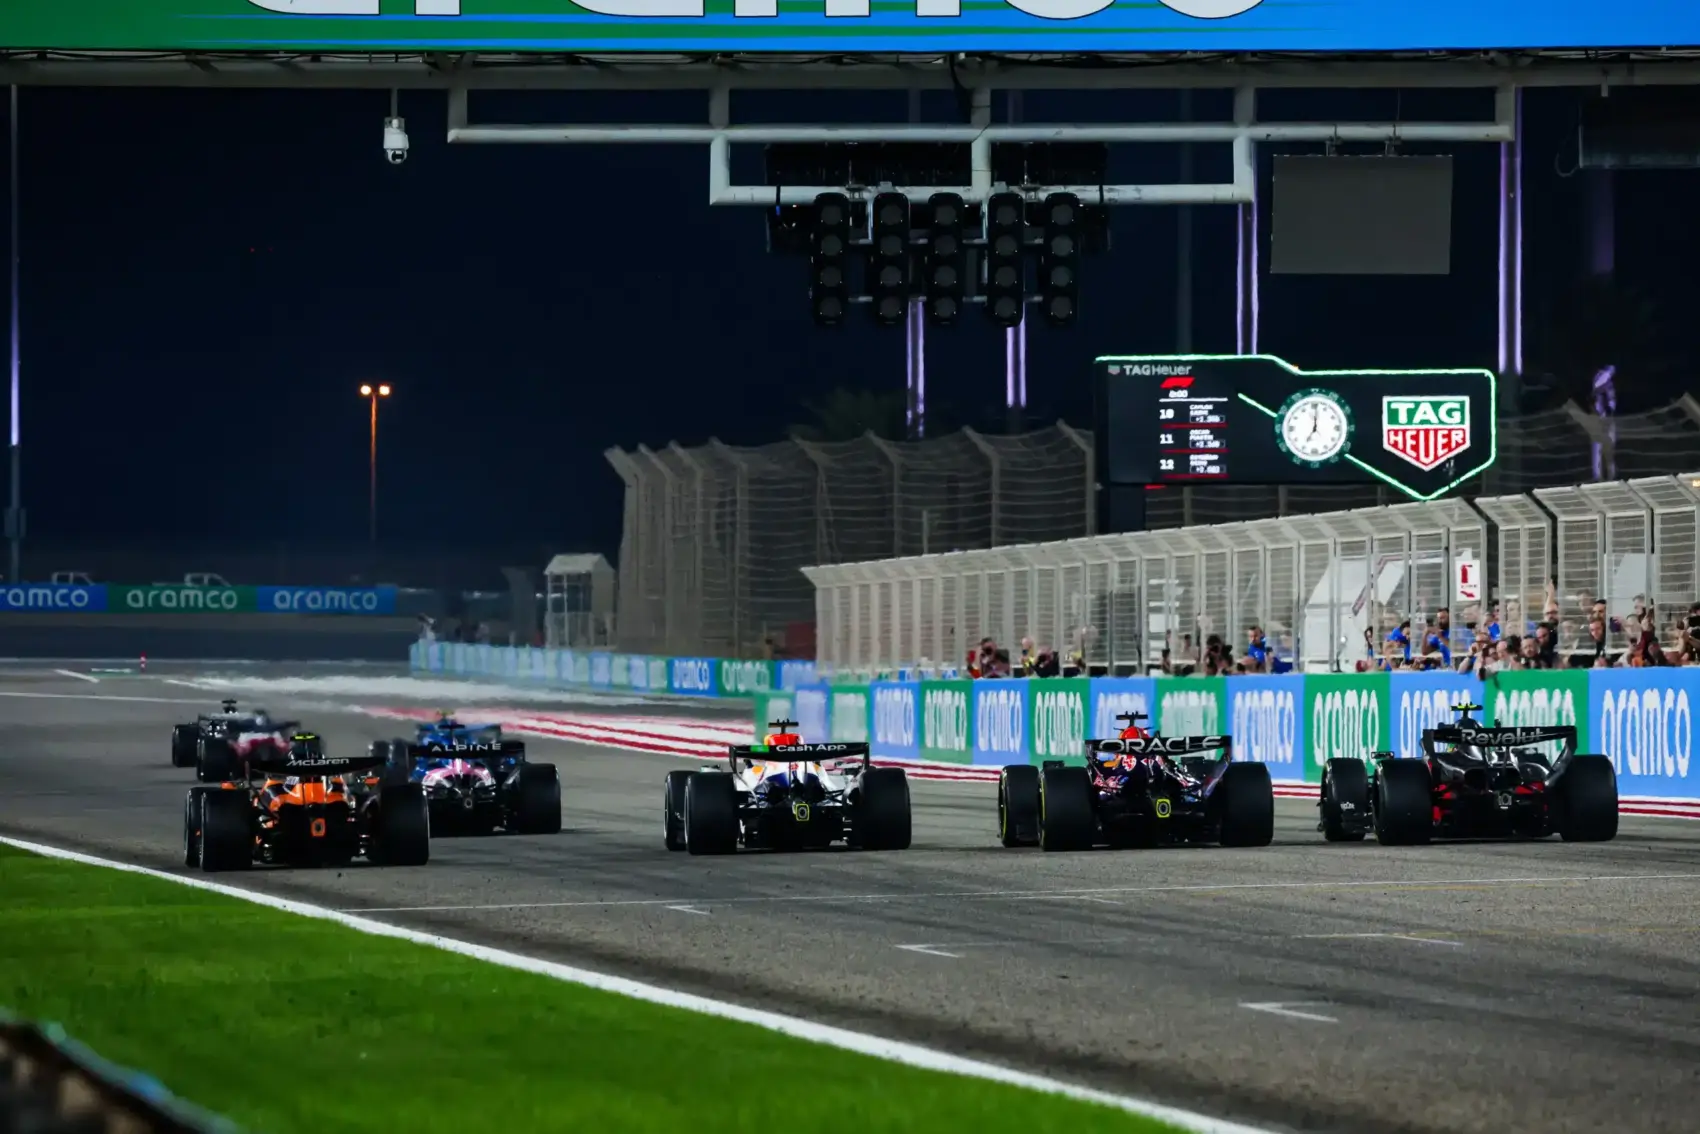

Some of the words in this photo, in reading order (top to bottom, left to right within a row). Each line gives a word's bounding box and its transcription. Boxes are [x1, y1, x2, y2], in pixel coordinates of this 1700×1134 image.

[1390, 401, 1462, 424] TAG
[1159, 433, 1175, 444] 11
[1388, 429, 1464, 464] HEUER
[1159, 459, 1175, 470] 12
[126, 587, 238, 610] aramco
[273, 588, 378, 611] aramco
[977, 689, 1023, 753] aramco
[1034, 691, 1084, 756] aramco
[1233, 690, 1295, 763] aramco
[1313, 689, 1379, 766] aramco
[1100, 735, 1223, 753] ORACLE
[1461, 727, 1544, 746] Revolut
[1601, 687, 1692, 779] aramco
[431, 741, 502, 753] ALPINE
[776, 743, 813, 752] Cash
[816, 743, 847, 752] App
[286, 758, 350, 766] McLaren
